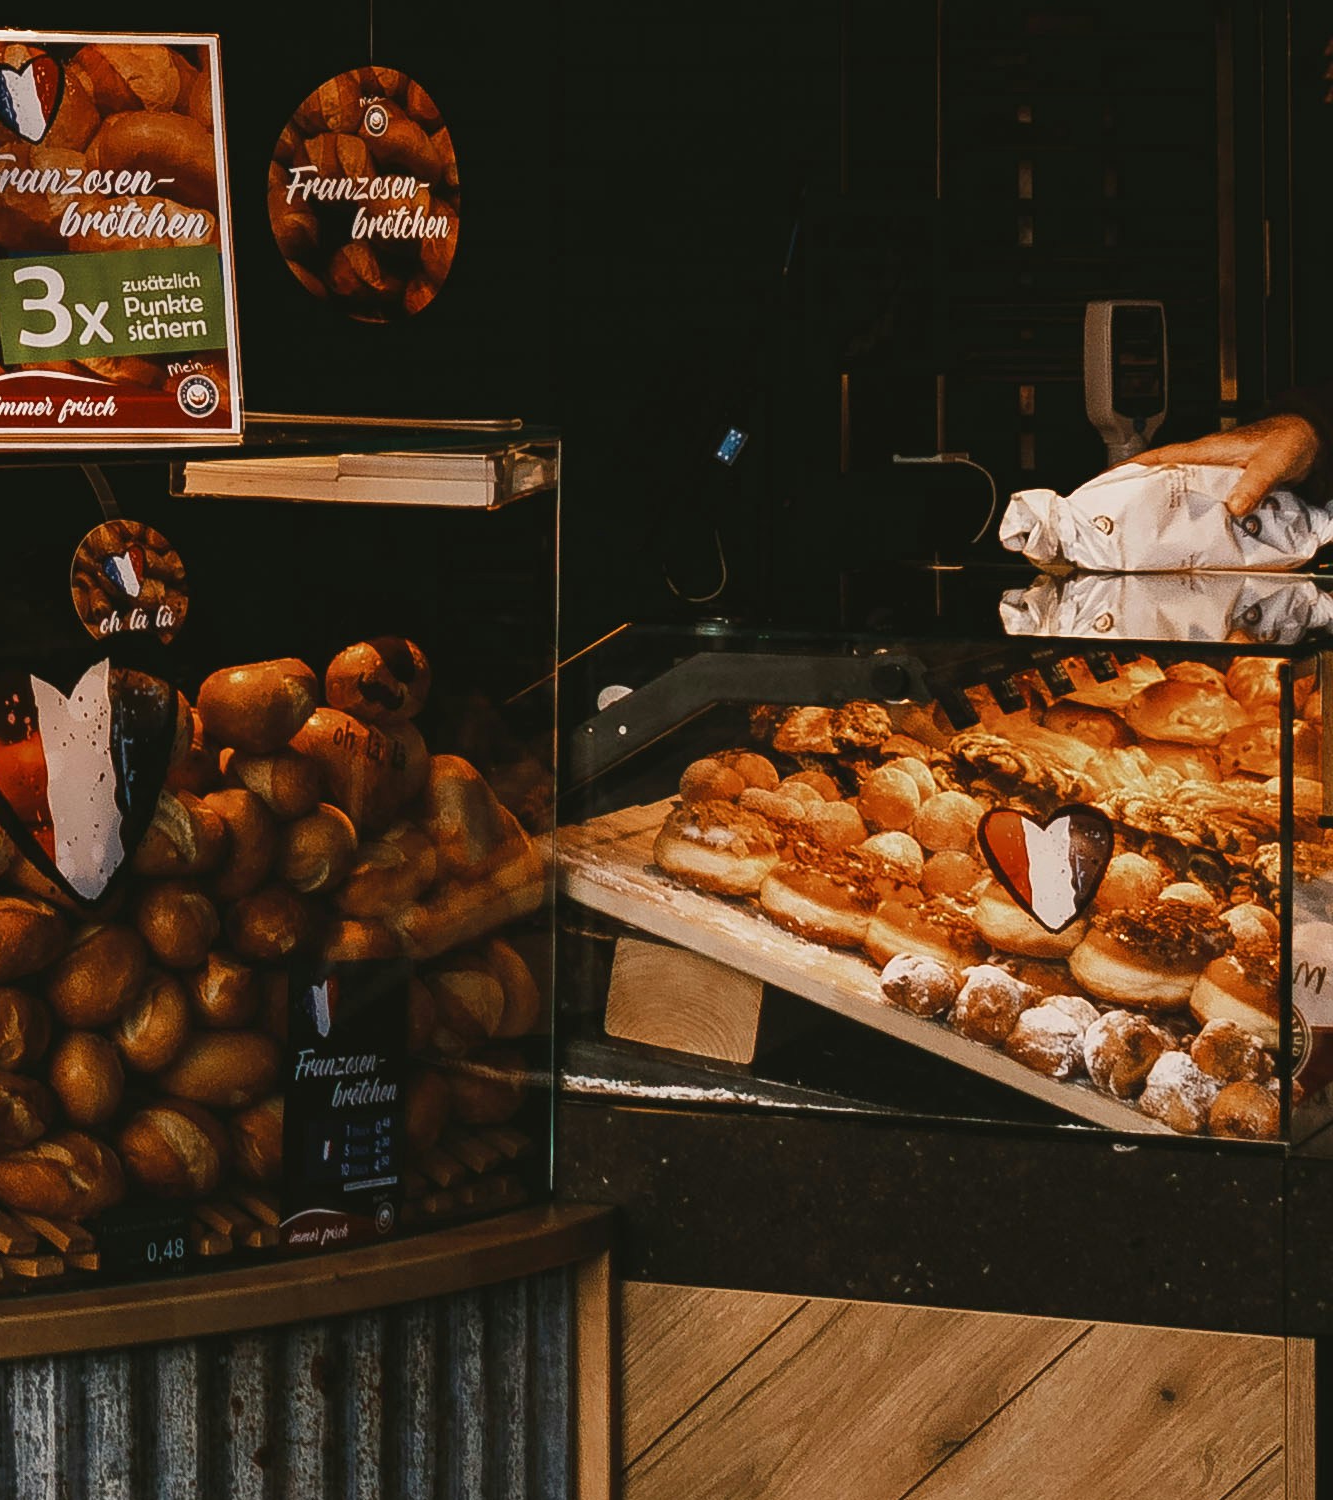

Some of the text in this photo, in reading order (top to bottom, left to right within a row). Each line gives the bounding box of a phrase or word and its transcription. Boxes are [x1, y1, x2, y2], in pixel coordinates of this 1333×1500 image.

[285, 165, 430, 205] Franzosen-
[59, 201, 211, 239] brötchen
[351, 205, 451, 240] brötchen
[121, 271, 201, 293] zusätzlich
[13, 265, 114, 348] 3x
[125, 294, 204, 318] Punkte
[128, 317, 208, 342] sichern
[57, 395, 119, 424] frisch
[100, 604, 175, 635] oh là là
[295, 1048, 387, 1081] Franzosen-
[332, 1077, 397, 1107] brötchen
[147, 1238, 184, 1264] 0,48
